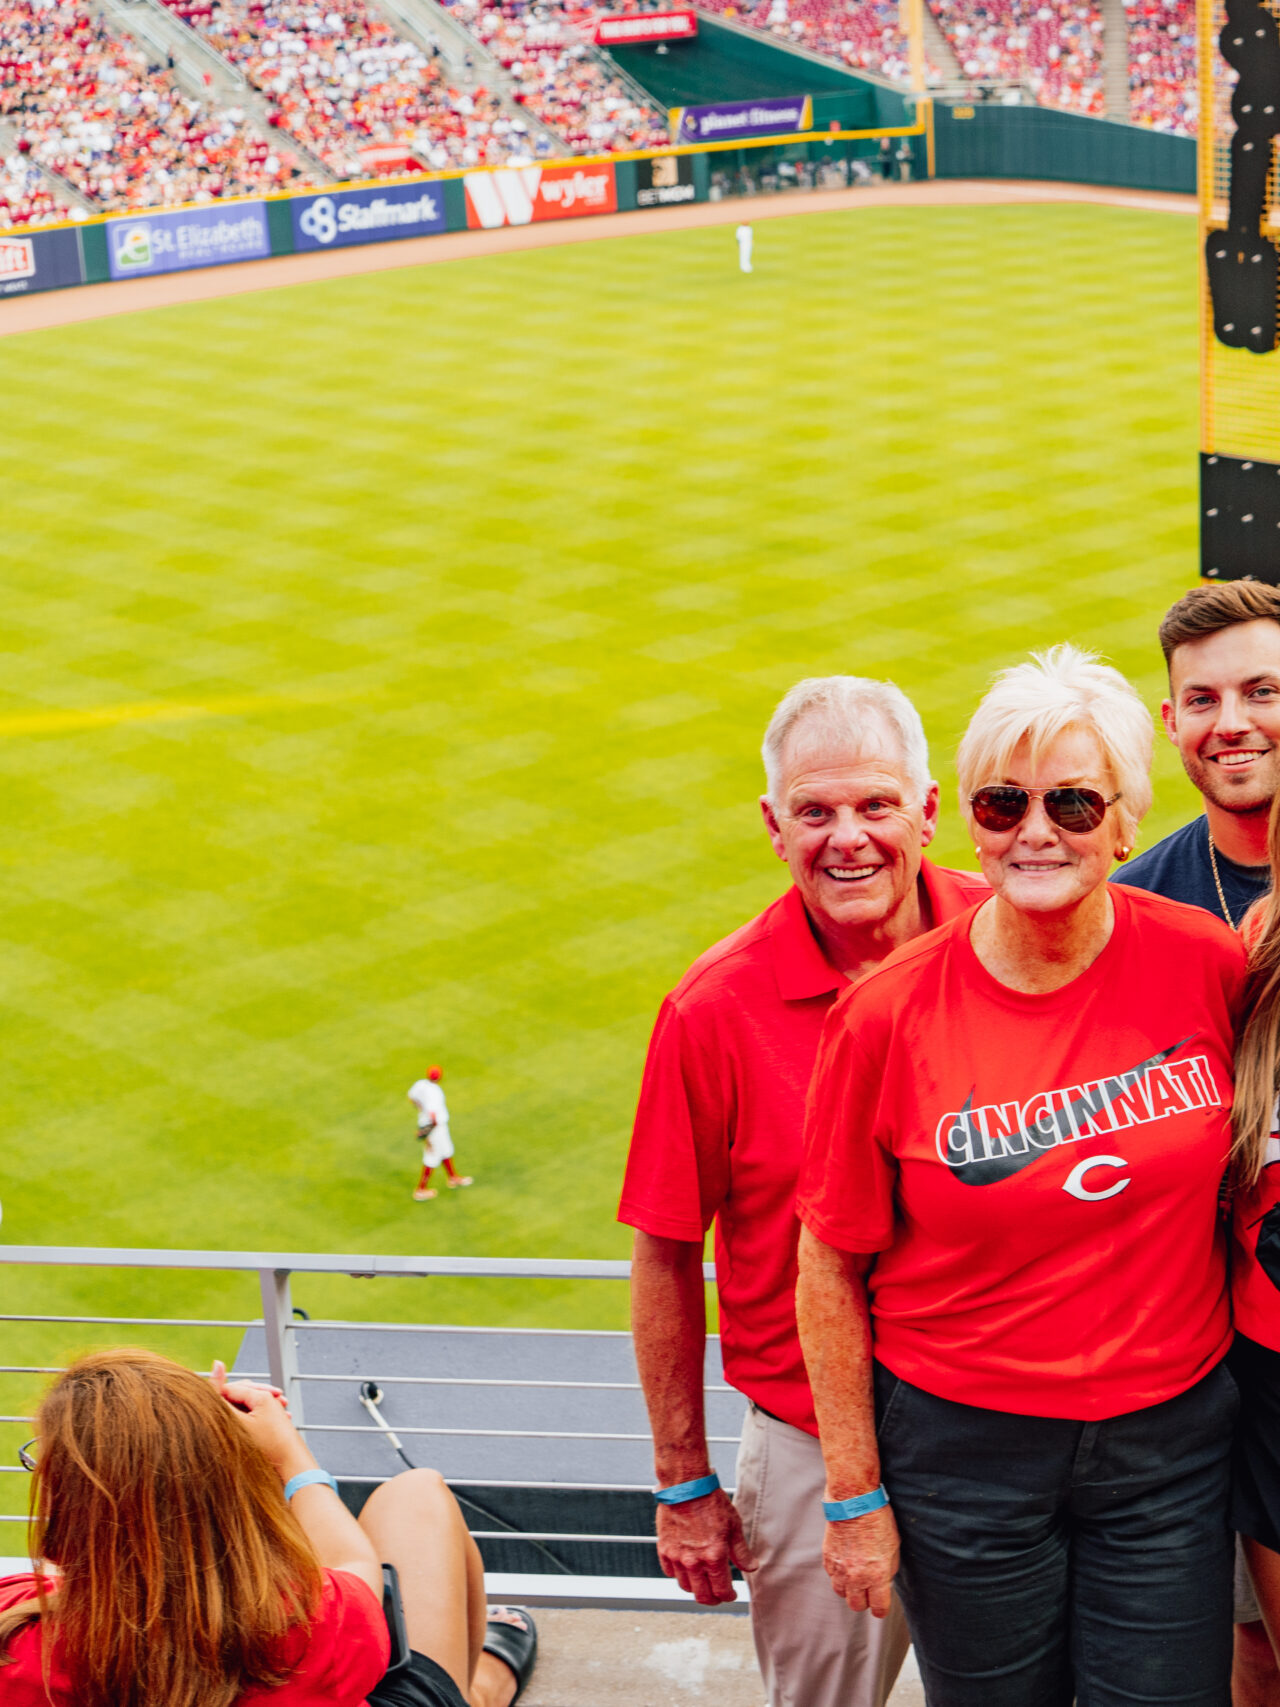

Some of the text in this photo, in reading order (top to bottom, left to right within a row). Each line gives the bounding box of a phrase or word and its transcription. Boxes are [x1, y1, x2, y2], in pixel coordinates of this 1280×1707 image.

[539, 171, 609, 208] wyler
[337, 194, 439, 232] Staffmark
[176, 216, 264, 251] Elizabeth
[934, 1054, 1222, 1167] CINCINNATI
